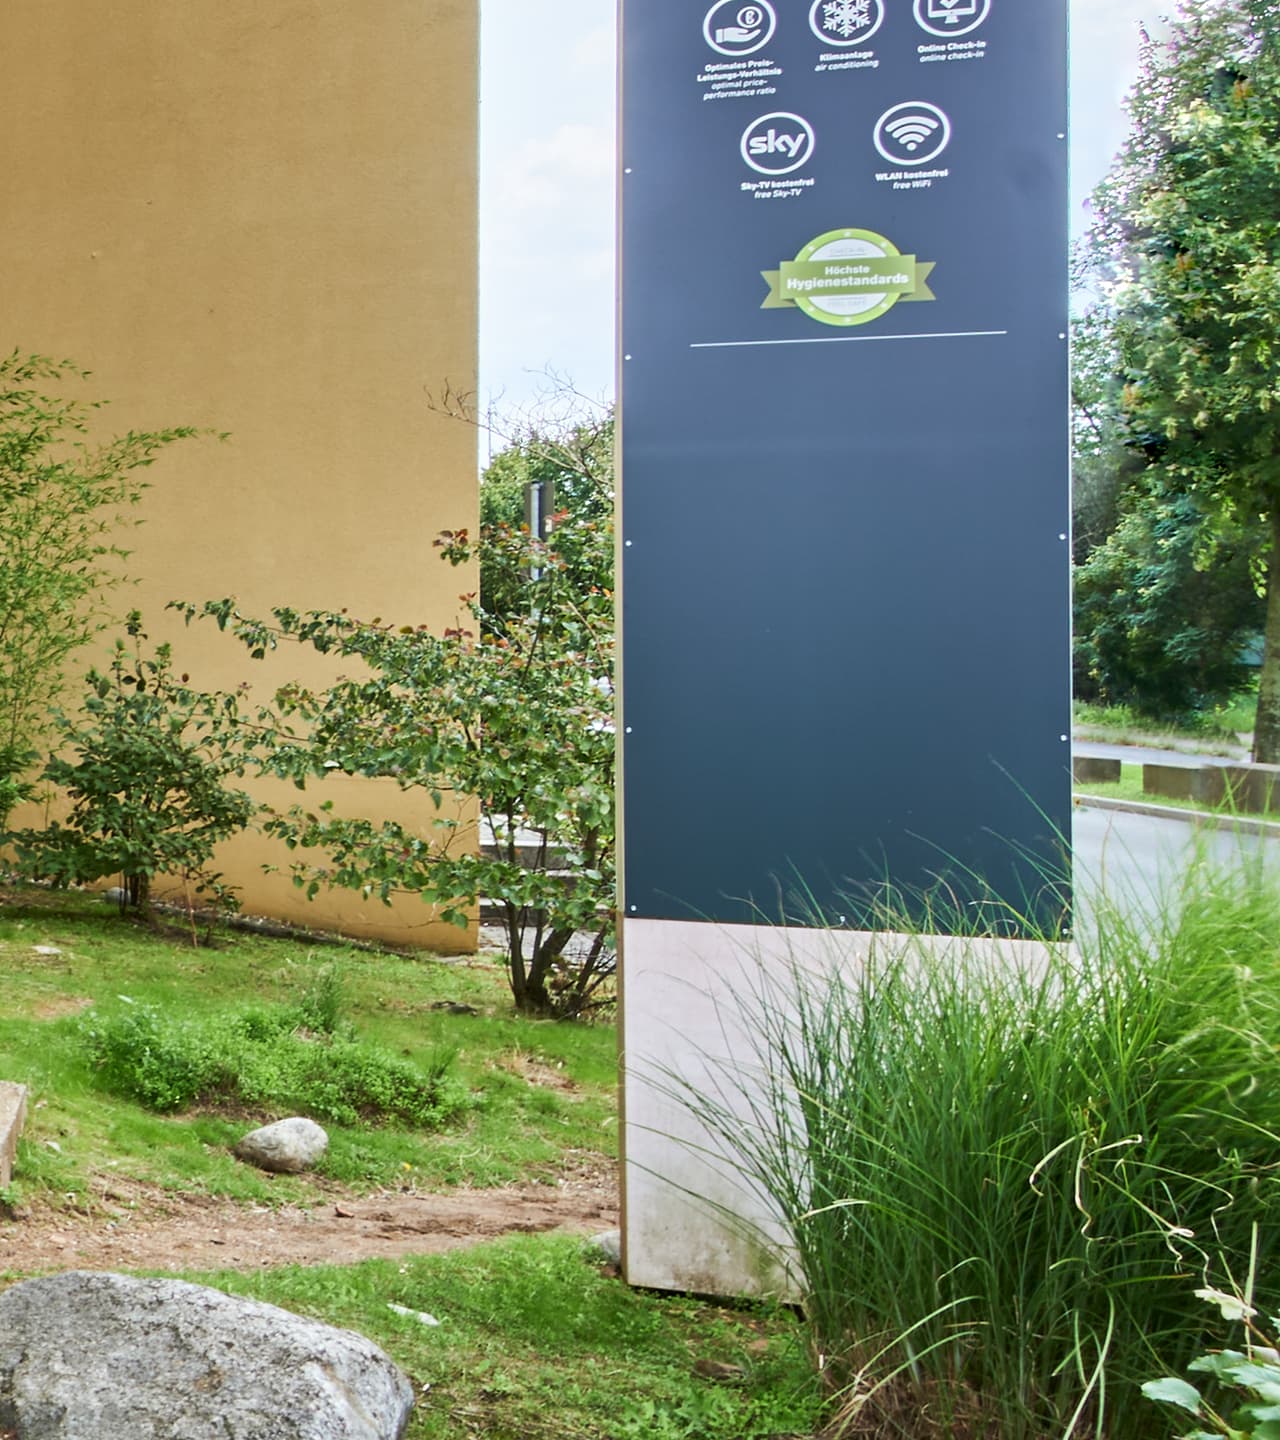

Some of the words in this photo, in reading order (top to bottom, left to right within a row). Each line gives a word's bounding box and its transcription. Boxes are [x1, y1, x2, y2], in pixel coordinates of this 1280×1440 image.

[917, 45, 946, 53] Online
[819, 51, 874, 61] Klimaanlage
[920, 54, 946, 62] online
[704, 62, 747, 72] Optimales
[827, 60, 879, 70] conditioning
[711, 80, 743, 90] optimal
[703, 89, 755, 101] performance
[756, 87, 776, 95] ratio
[749, 129, 805, 158] sky
[874, 172, 903, 181] WLAN
[903, 169, 948, 179] kostenfrei
[740, 181, 770, 191] Sky-TV
[771, 178, 814, 188] kostenfrei
[893, 181, 911, 189] free
[754, 191, 772, 199] free
[773, 188, 802, 198] Sky-TV
[824, 264, 870, 275] Höchste
[787, 273, 910, 290] Hygienestandards
